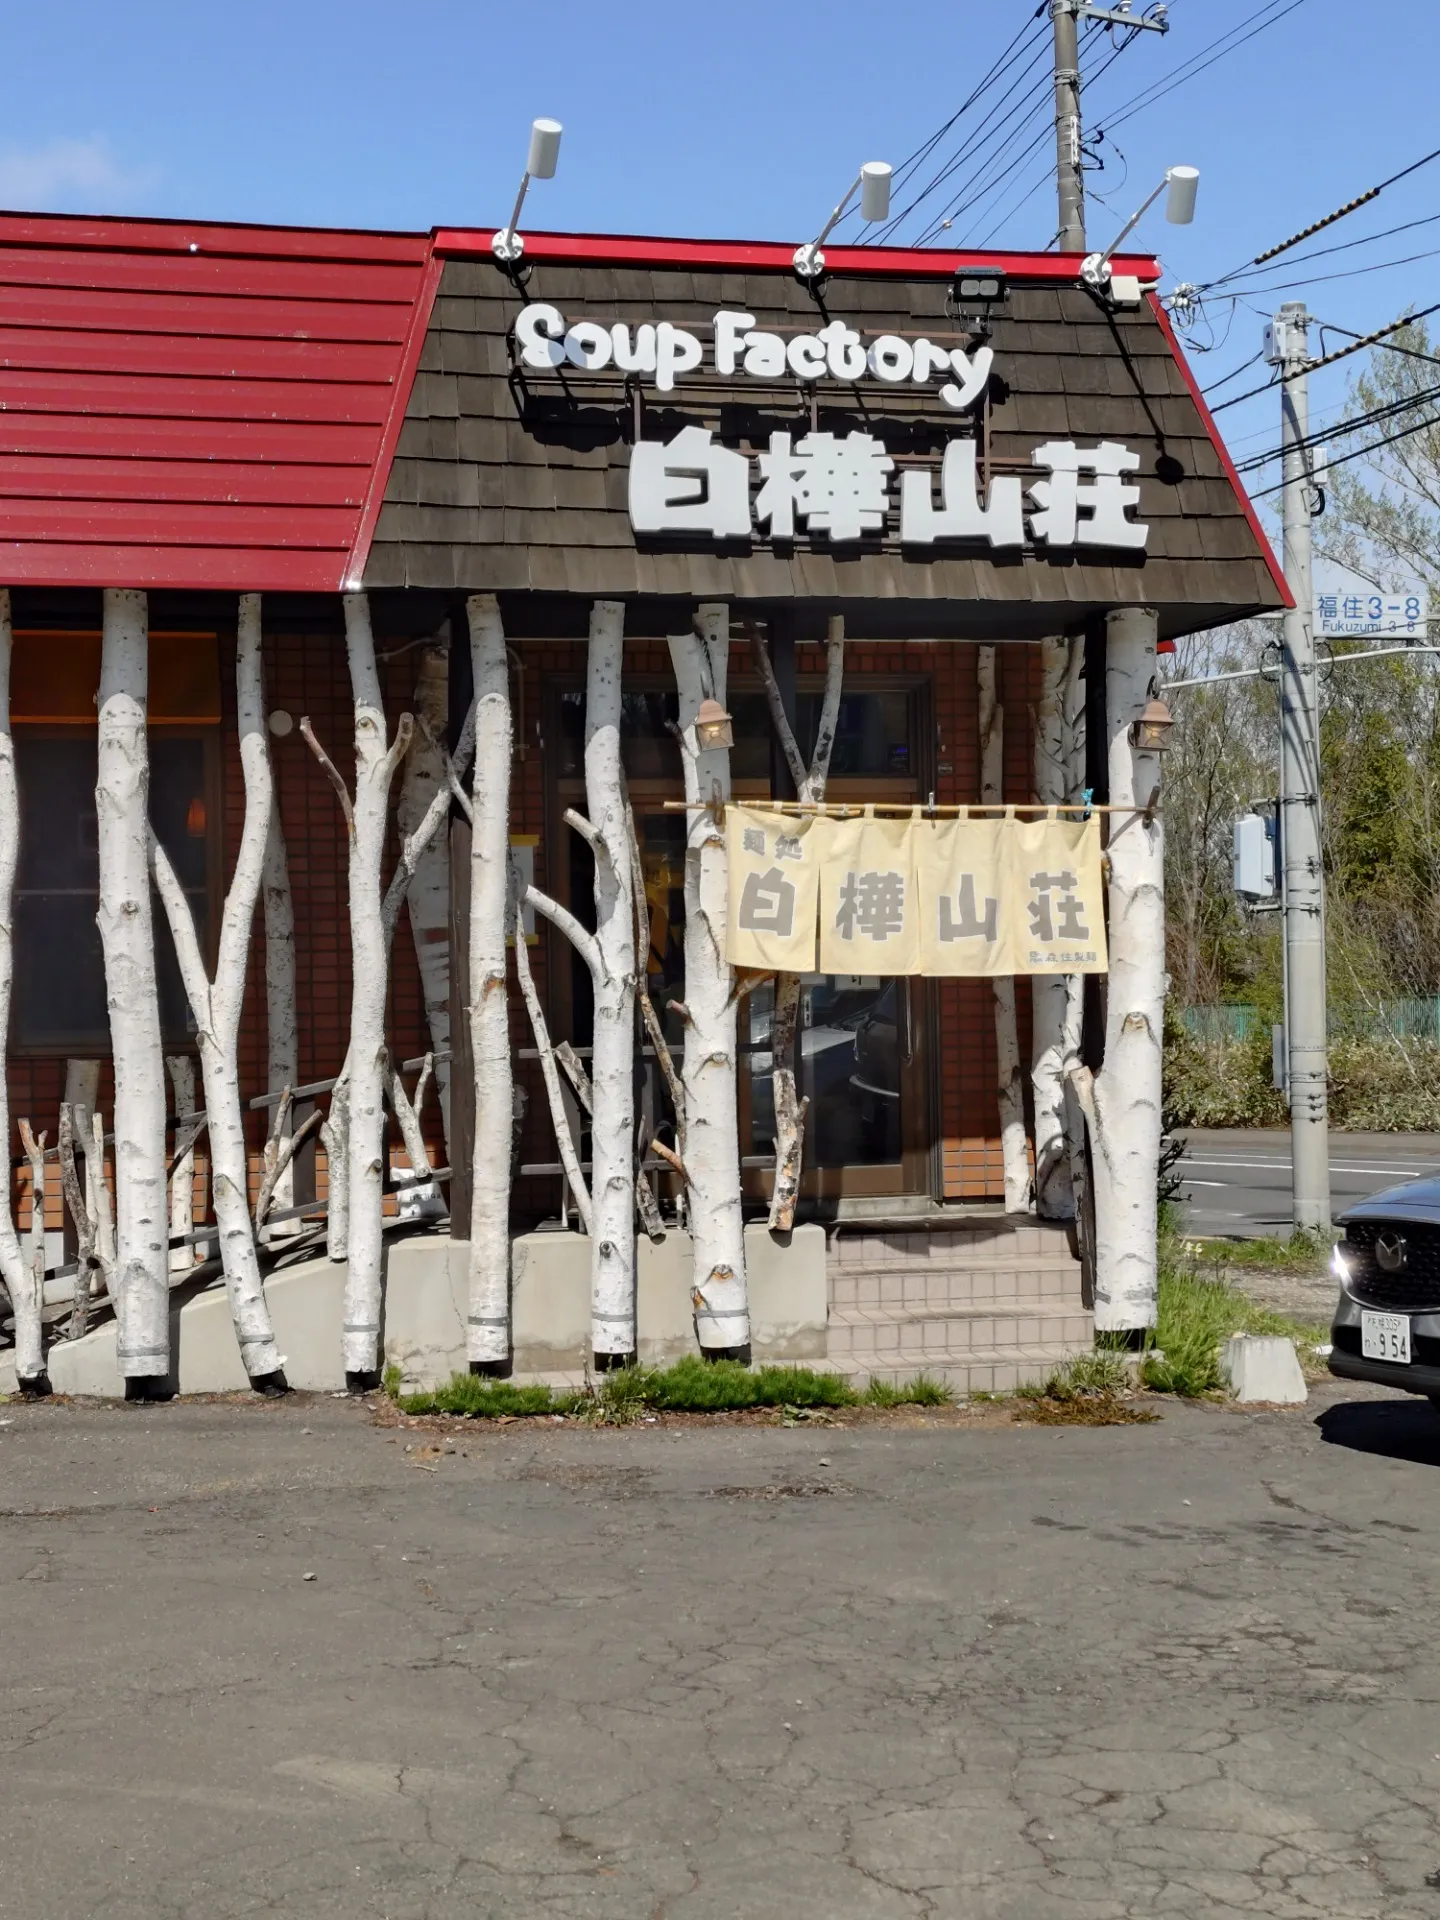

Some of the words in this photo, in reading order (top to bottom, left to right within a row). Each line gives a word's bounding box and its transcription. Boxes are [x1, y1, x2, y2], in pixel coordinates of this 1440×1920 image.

[514, 303, 702, 391] Soup
[713, 310, 994, 408] Factory
[629, 424, 1149, 549] 白樺山荘
[1322, 619, 1381, 633] Fukuzumi
[742, 826, 803, 860] 麺処
[738, 866, 1090, 942] 白樺山荘
